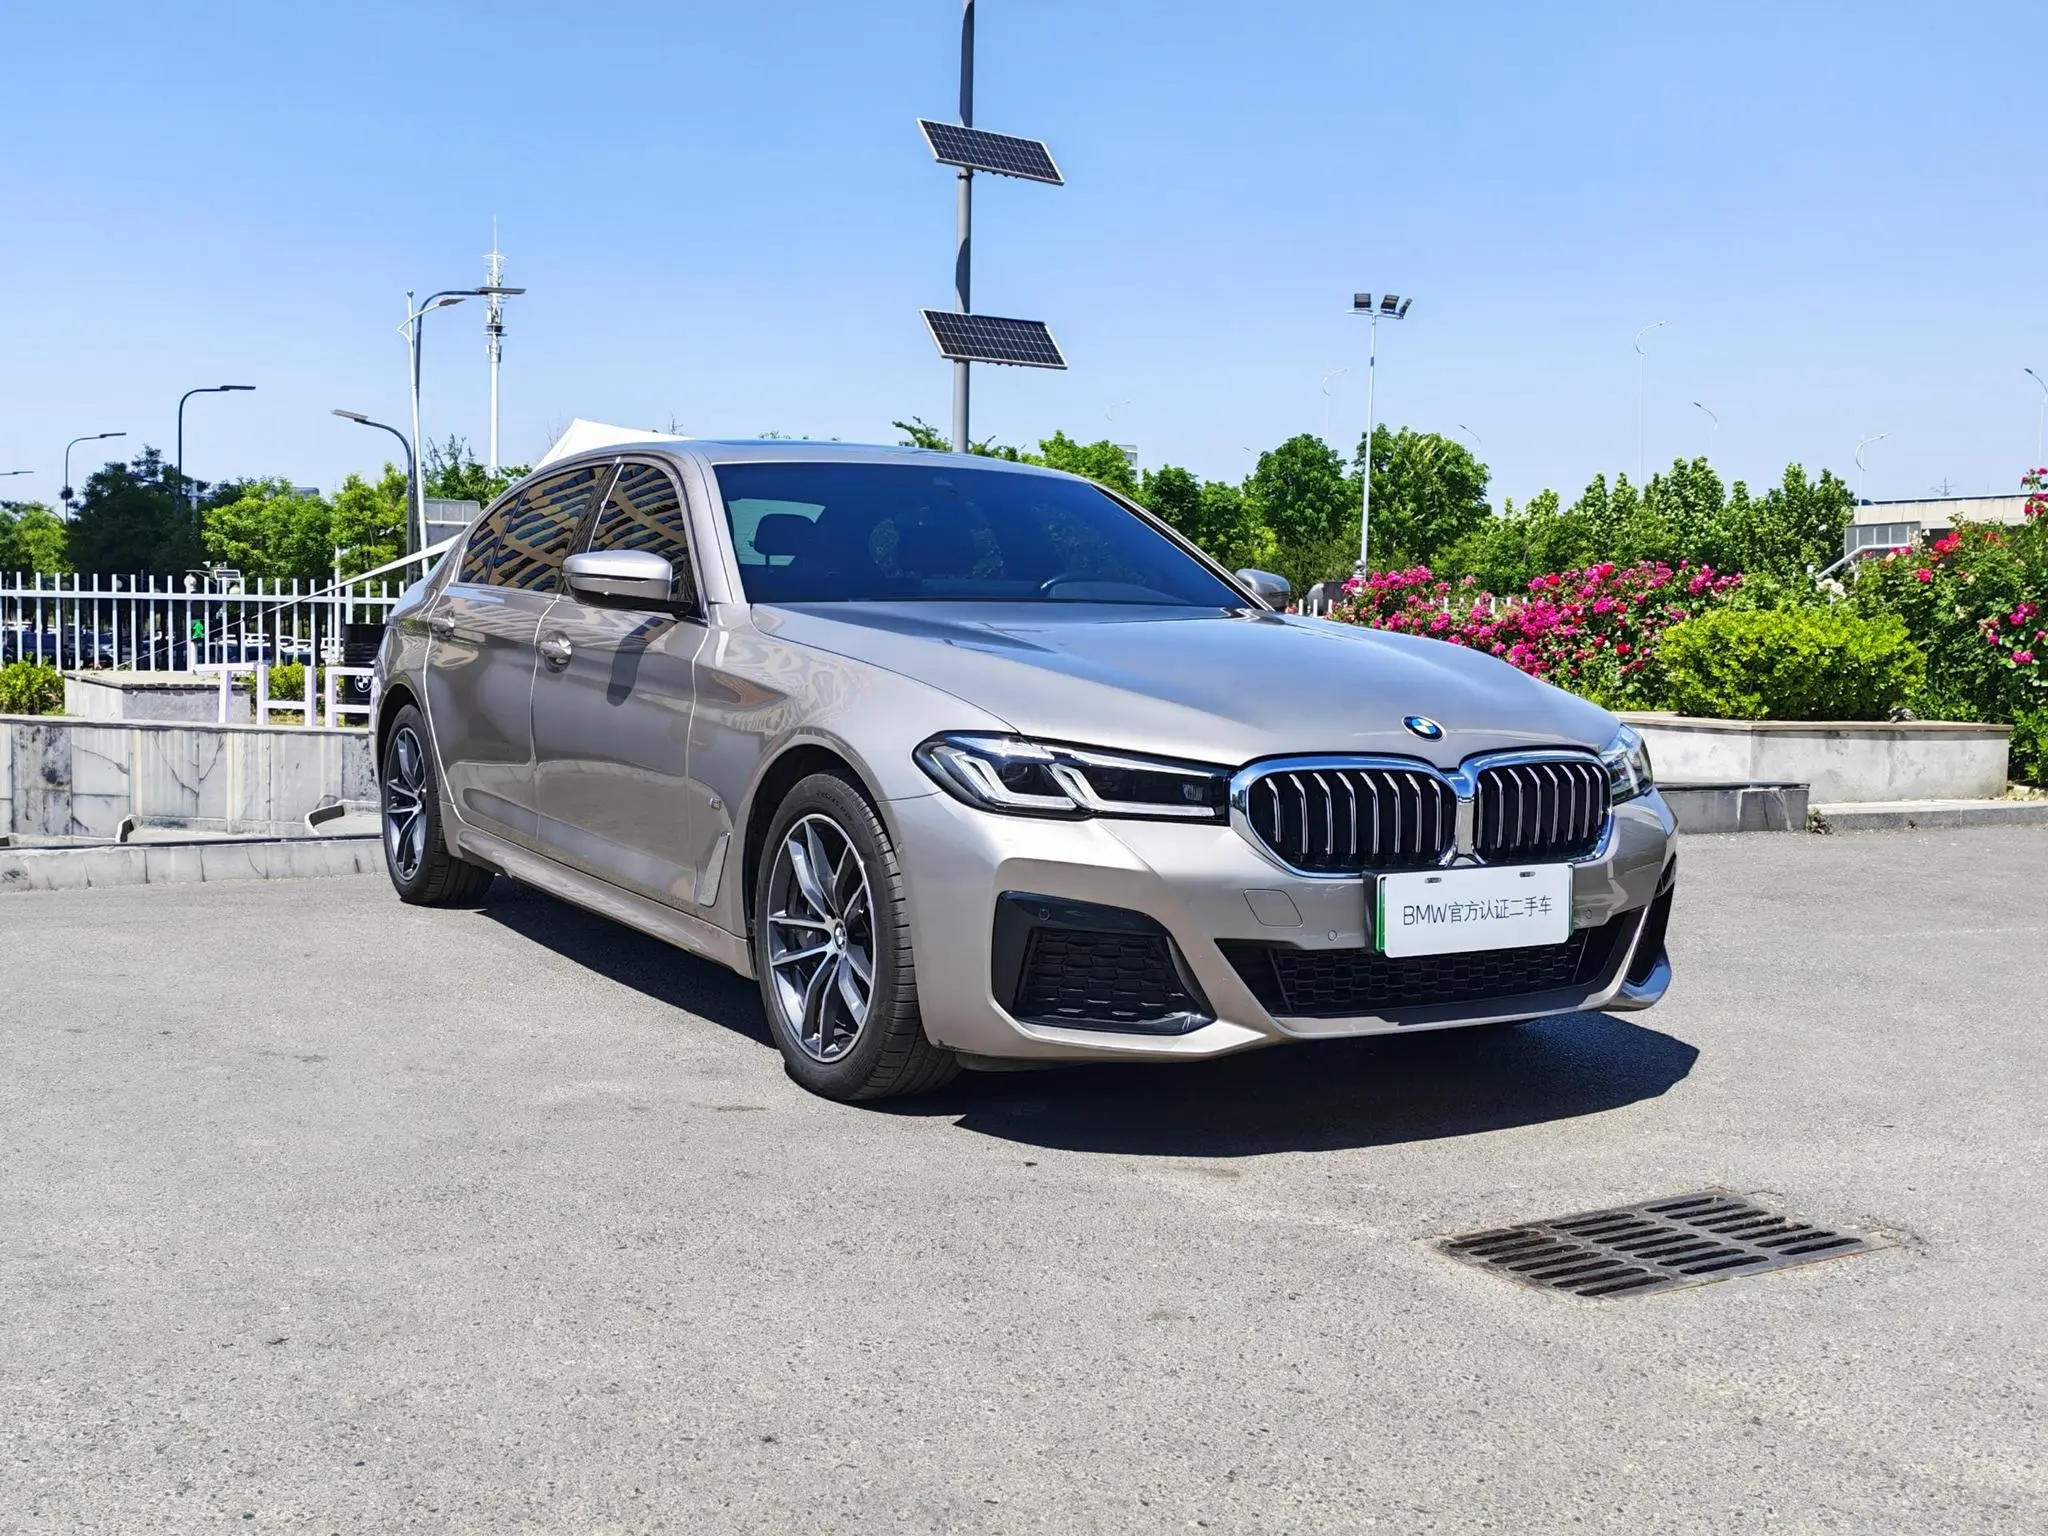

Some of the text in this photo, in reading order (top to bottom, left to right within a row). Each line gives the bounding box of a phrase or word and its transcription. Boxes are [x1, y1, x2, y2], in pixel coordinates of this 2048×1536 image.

[1402, 894, 1554, 926] BMW官方认证二手车
